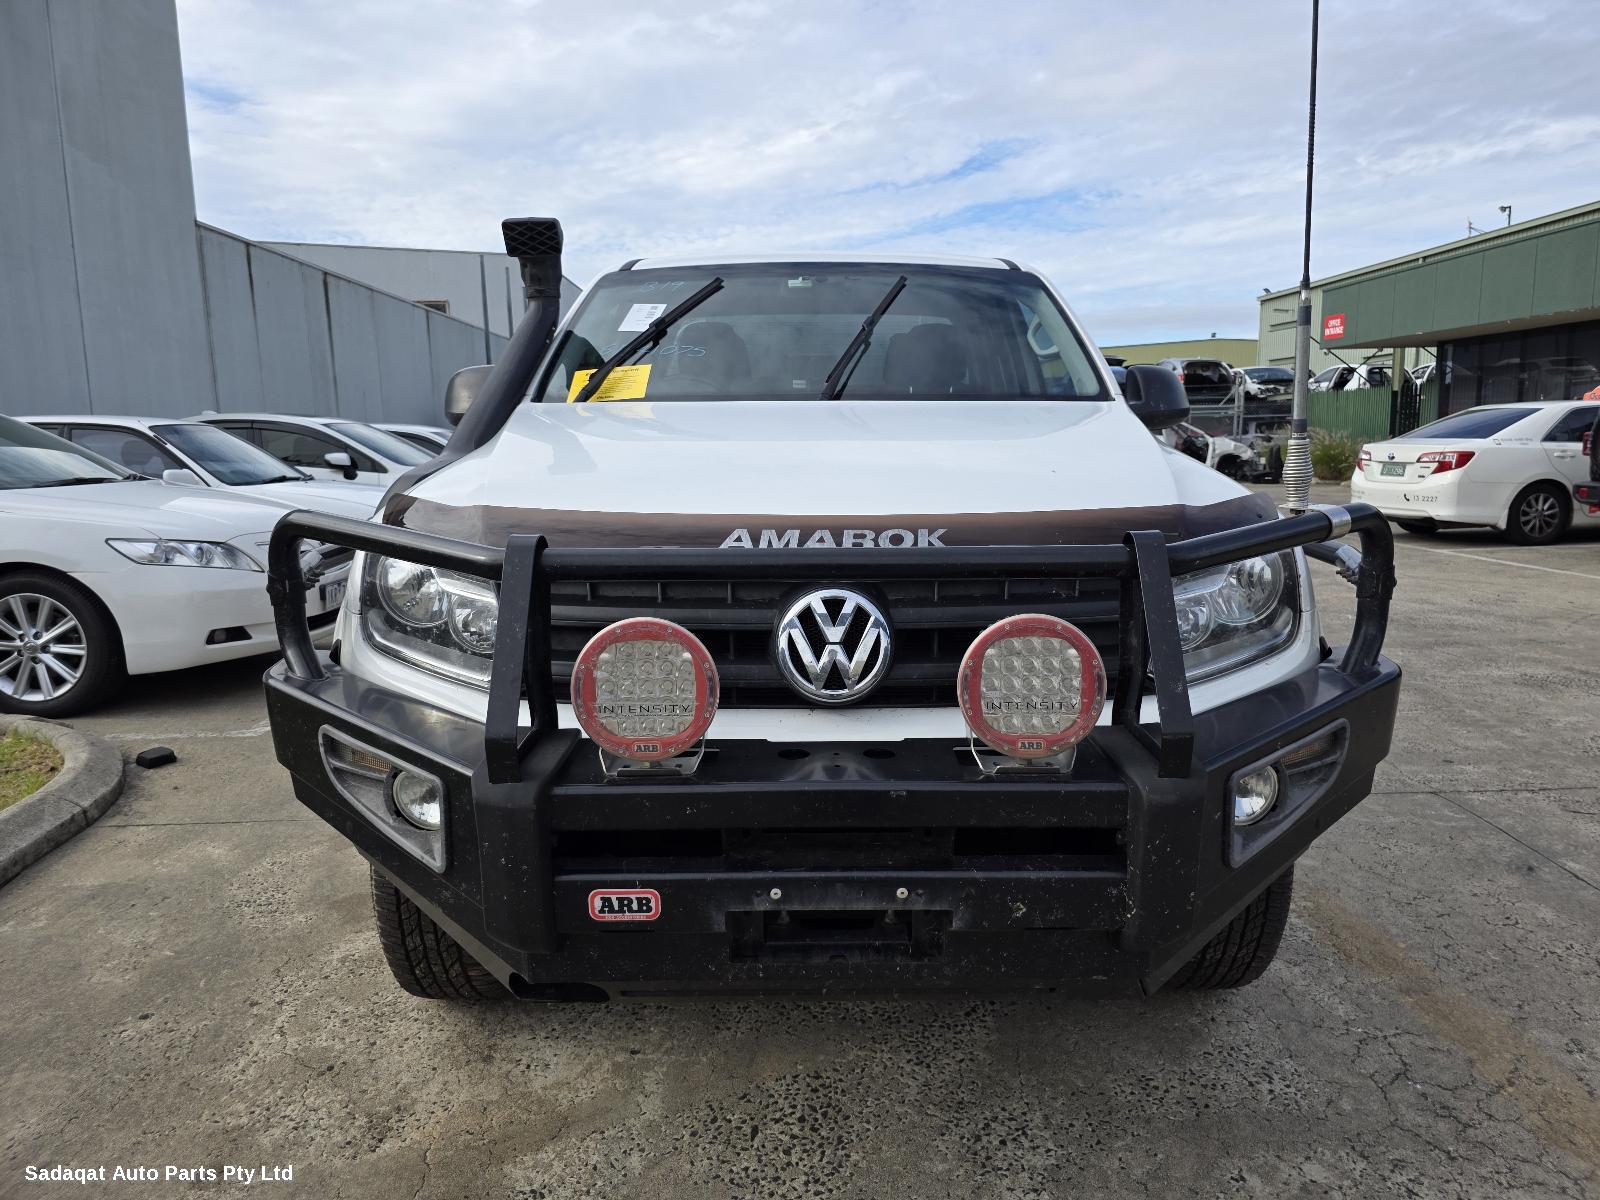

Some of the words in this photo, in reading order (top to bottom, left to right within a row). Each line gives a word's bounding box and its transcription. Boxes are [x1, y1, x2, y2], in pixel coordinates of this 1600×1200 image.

[1421, 495, 1438, 503] 2227
[719, 528, 948, 549] AMAROK
[598, 703, 691, 715] INTENSITY
[985, 701, 1079, 711] INTENSITY
[634, 744, 659, 753] ARB
[1019, 741, 1042, 750] ARB
[597, 896, 654, 914] ARB
